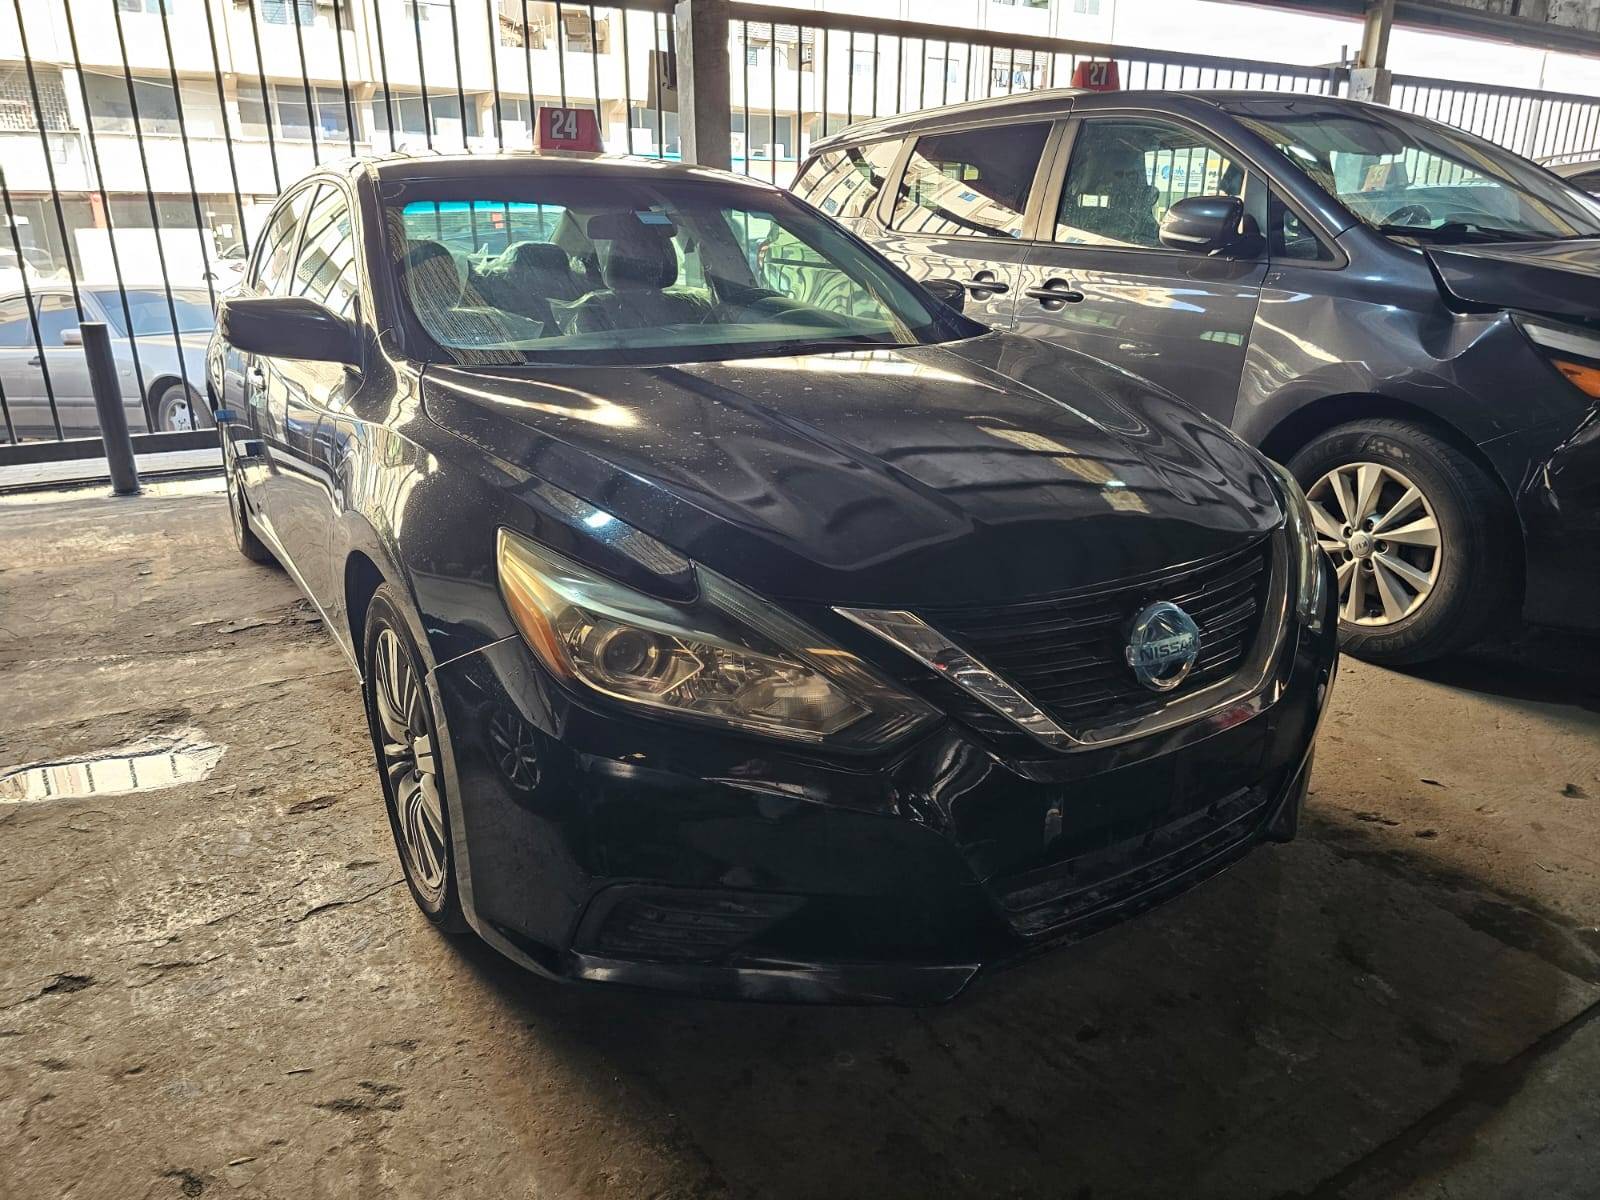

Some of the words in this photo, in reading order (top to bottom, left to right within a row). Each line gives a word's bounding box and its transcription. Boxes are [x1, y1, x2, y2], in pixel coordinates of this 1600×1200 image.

[1089, 62, 1107, 85] 27
[551, 110, 578, 139] 24
[1139, 637, 1193, 662] NISSAN
